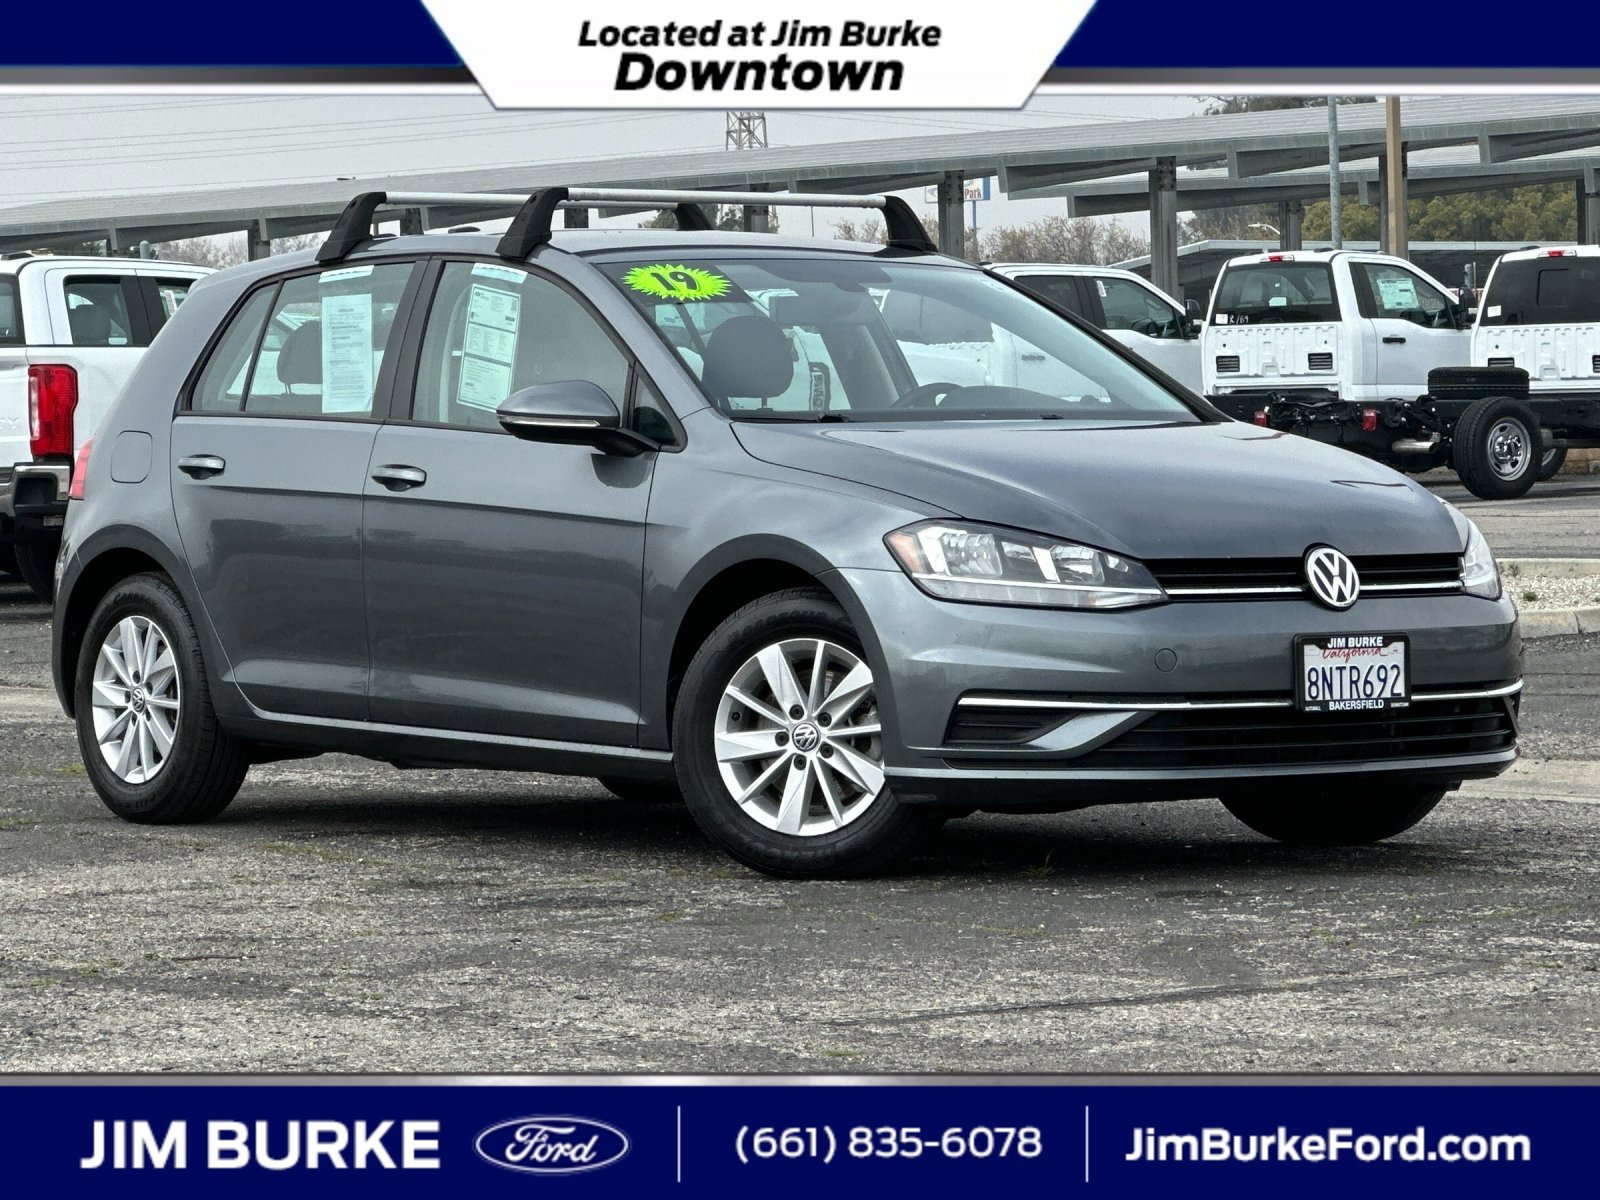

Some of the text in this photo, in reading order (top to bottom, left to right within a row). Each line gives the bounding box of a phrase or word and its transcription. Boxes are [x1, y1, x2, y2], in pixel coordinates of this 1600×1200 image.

[964, 188, 982, 199] Park
[650, 271, 698, 291] 19
[1327, 636, 1383, 648] JIM BURKE
[1307, 664, 1402, 700] 8NTR692
[1328, 699, 1385, 711] BAKERSFIELD
